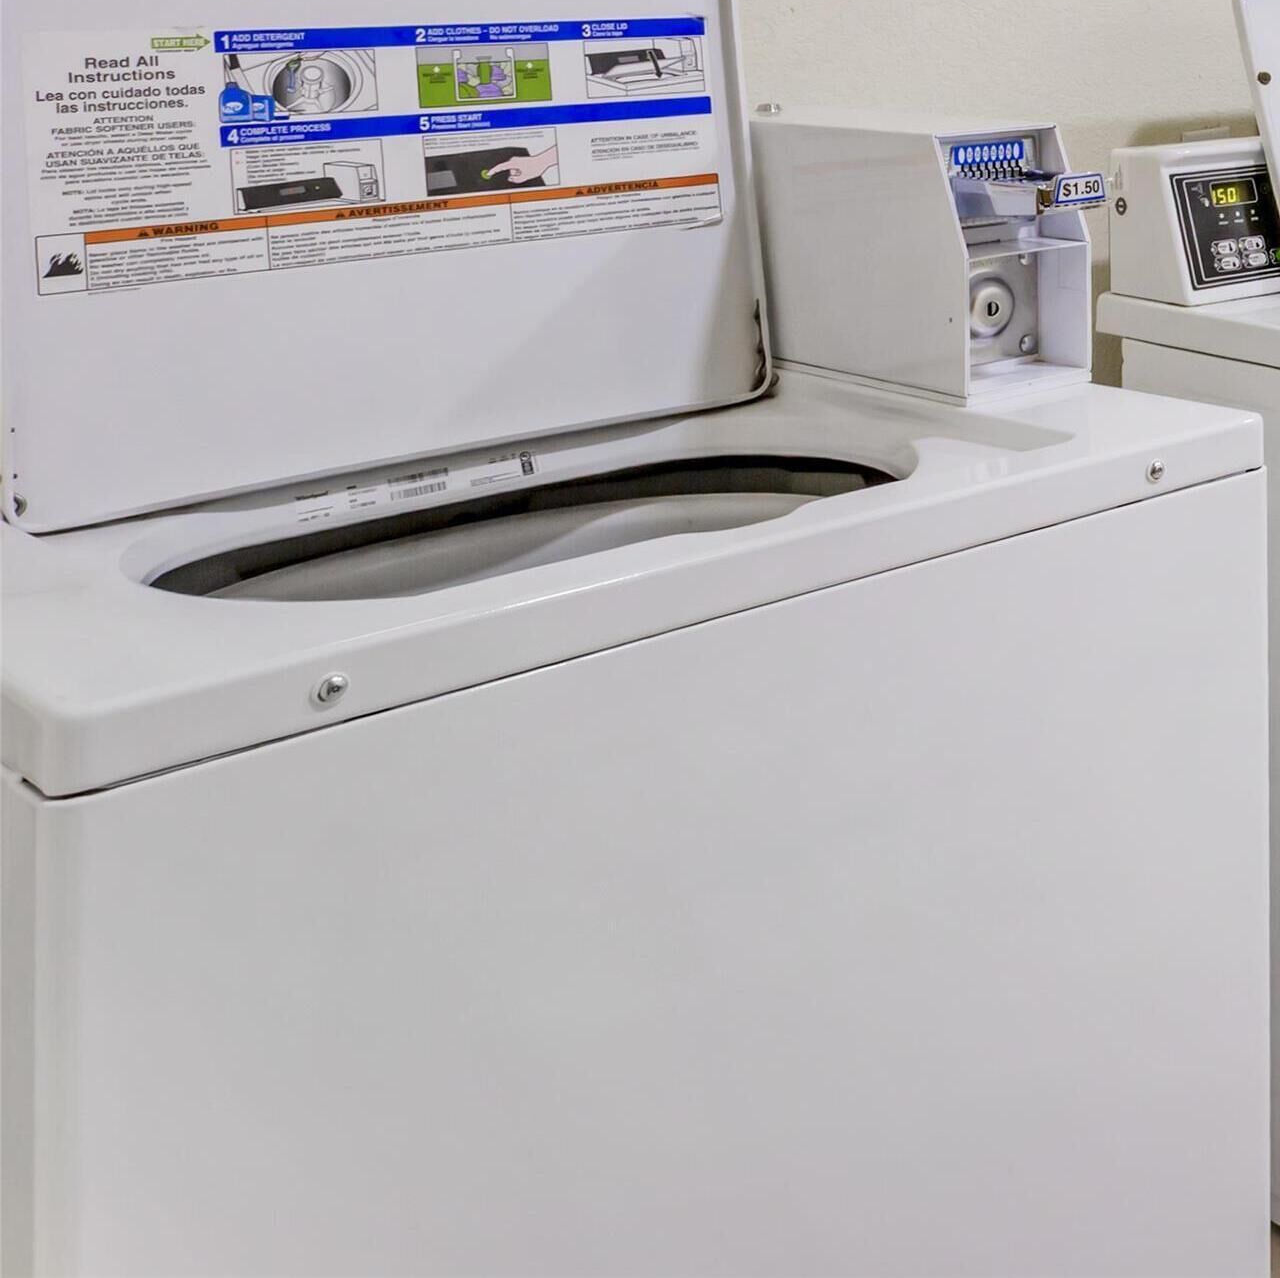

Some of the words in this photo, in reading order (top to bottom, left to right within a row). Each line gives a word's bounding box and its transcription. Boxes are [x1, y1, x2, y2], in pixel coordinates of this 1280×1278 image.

[415, 28, 427, 42] 2
[489, 26, 501, 34] DO
[502, 25, 518, 33] NOT
[519, 24, 560, 33] OVERLOAD
[582, 24, 591, 37] 3
[220, 34, 230, 49] 1
[232, 34, 251, 42] ADD
[252, 32, 306, 42] DETERGENT
[85, 56, 131, 70] Read
[136, 55, 160, 68] All
[68, 69, 176, 83] Instructions
[35, 90, 64, 102] Lea
[68, 90, 97, 101] con
[101, 86, 162, 100] cuidado
[166, 84, 206, 96] todas
[56, 102, 79, 114] las
[83, 99, 189, 113] instrucciones.
[93, 115, 154, 125] ATTENTION
[420, 116, 430, 131] 5
[51, 125, 93, 135] FABRIC
[95, 123, 156, 133] SOFTENER
[227, 128, 240, 144] 4
[240, 126, 289, 136] COMPLETE
[290, 123, 332, 133] PROCESS
[46, 148, 107, 160] ATENCIÓN
[108, 148, 116, 157] A
[117, 143, 176, 155] AQUÉLLOS
[178, 142, 201, 152] QUE
[46, 158, 78, 169] USAN
[80, 154, 149, 166] SUAVIZANTE
[152, 153, 166, 161] DE
[587, 180, 660, 194] ADVERTENCIA
[1062, 179, 1101, 198] $1.50
[349, 200, 450, 217] AVERTISSEMENT
[152, 222, 220, 236] WARNING
